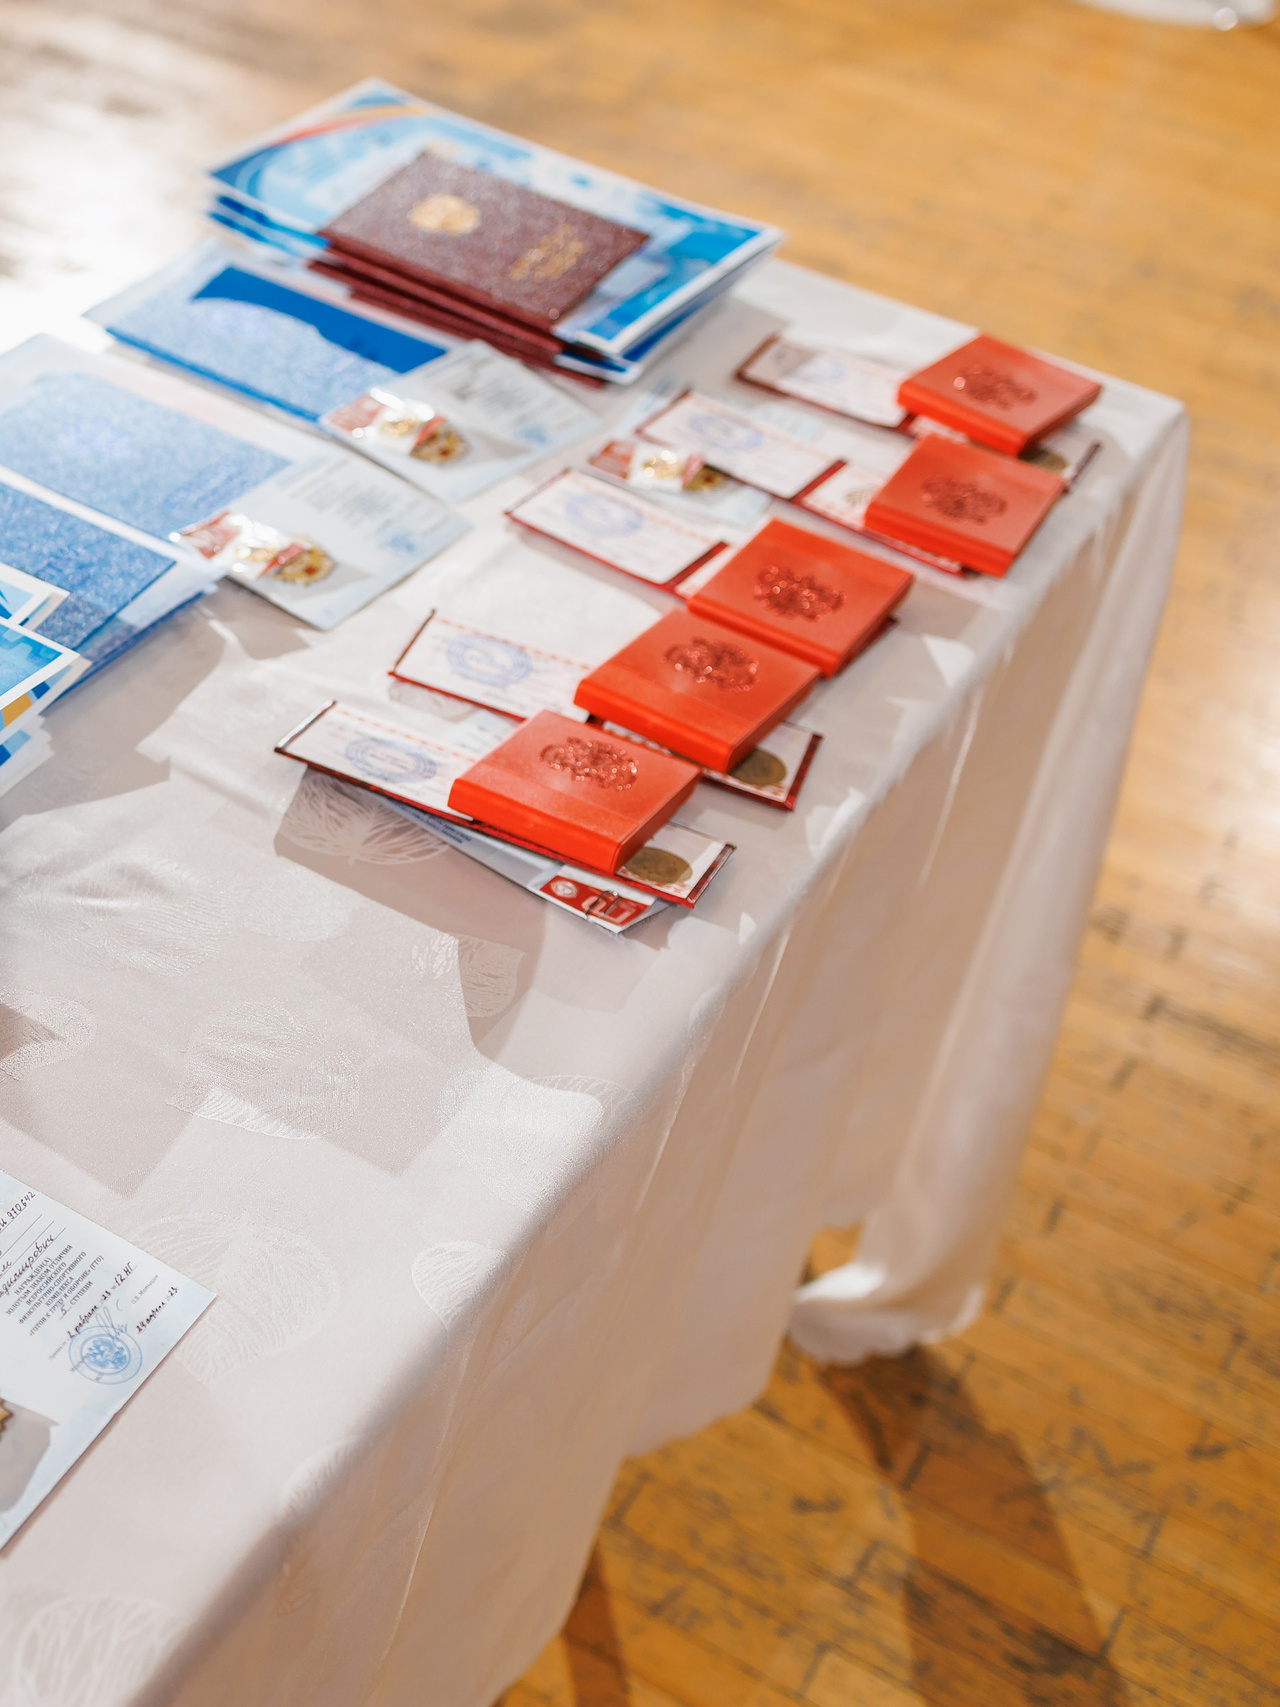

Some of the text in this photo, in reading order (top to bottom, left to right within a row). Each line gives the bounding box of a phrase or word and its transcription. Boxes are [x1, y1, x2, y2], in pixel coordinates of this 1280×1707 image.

[5, 1245, 72, 1314] ЗОЛОТЫМ ЗНАКОМ ОТЛИЧИЯ
[13, 1257, 52, 1294] НАГРАЖДЕН(А)
[18, 1252, 86, 1323] ФИЗКУЛЬТУРНО-СПОРТИВНОГО
[26, 1262, 66, 1305] ВСЕРОССИЙСКОГО
[46, 1276, 72, 1305] КОМПЛЕКСА
[50, 1298, 63, 1313] ТРУДУ
[67, 1269, 90, 1293] ОБОРОНЕ»
[89, 1255, 104, 1270] (ГТО)
[70, 1281, 91, 1305] СТУПЕНИ
